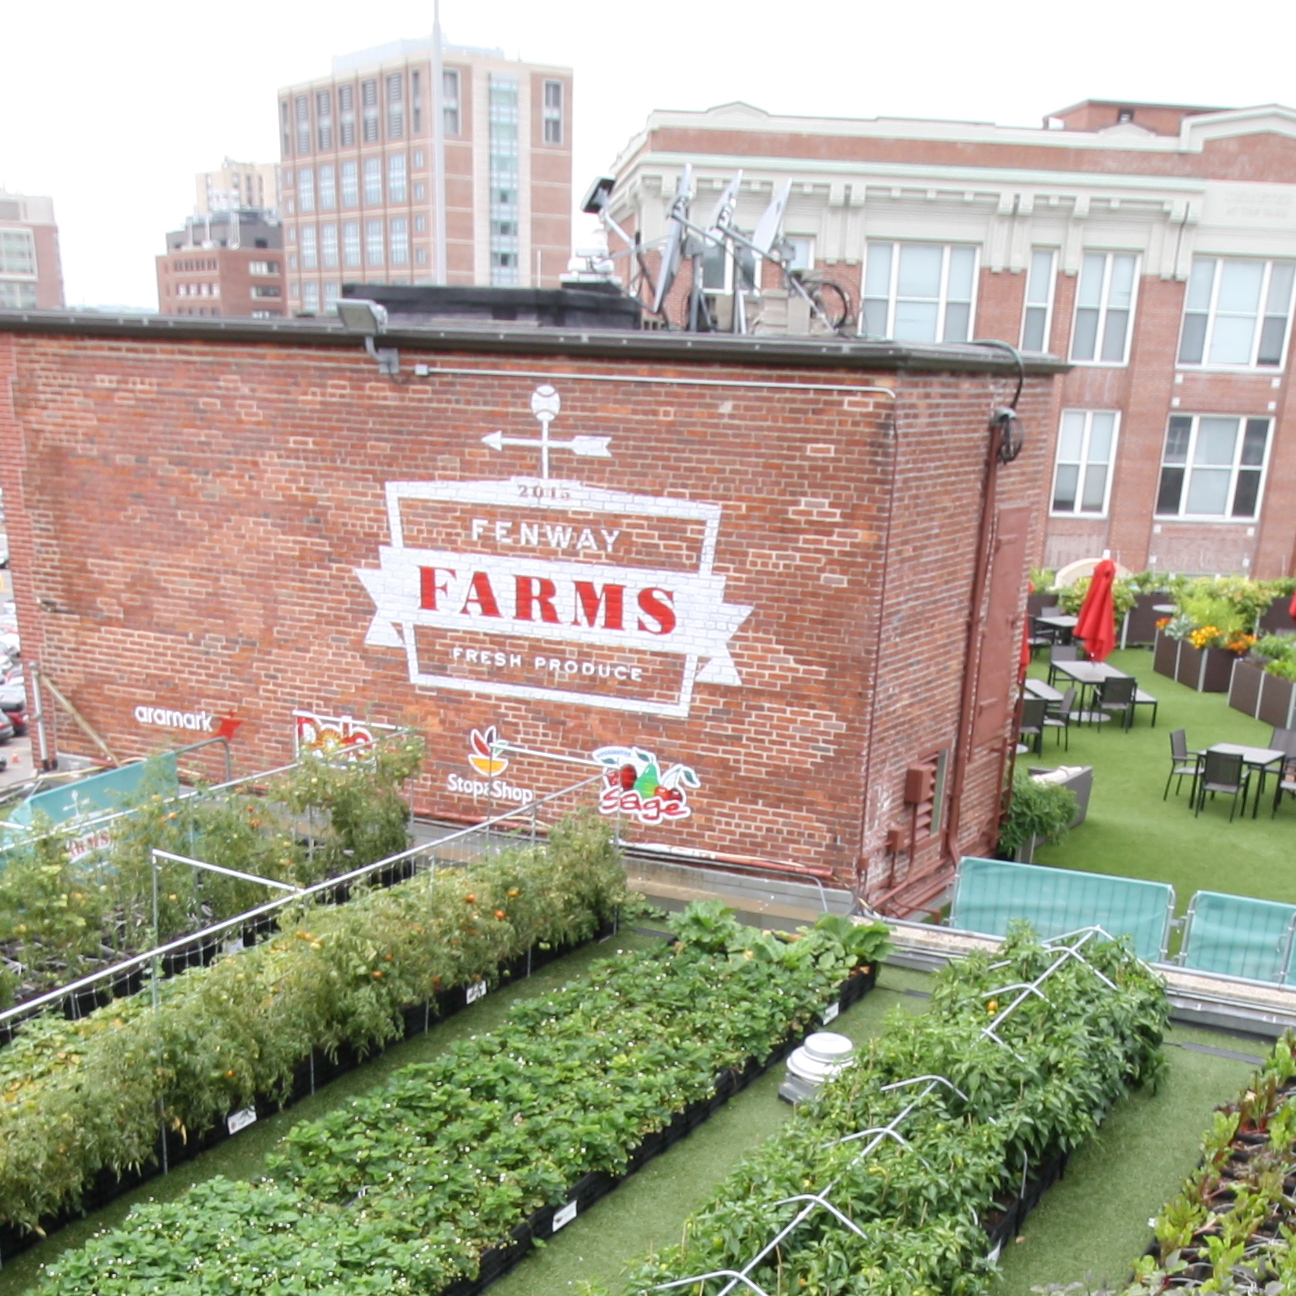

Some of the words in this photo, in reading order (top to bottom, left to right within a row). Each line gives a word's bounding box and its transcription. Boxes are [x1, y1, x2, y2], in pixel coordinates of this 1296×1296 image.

[471, 518, 622, 552] FENWAY
[418, 565, 678, 636] FARMS
[452, 646, 523, 669] FRESH
[534, 656, 644, 682] PRODUCE
[134, 705, 215, 733] aramark
